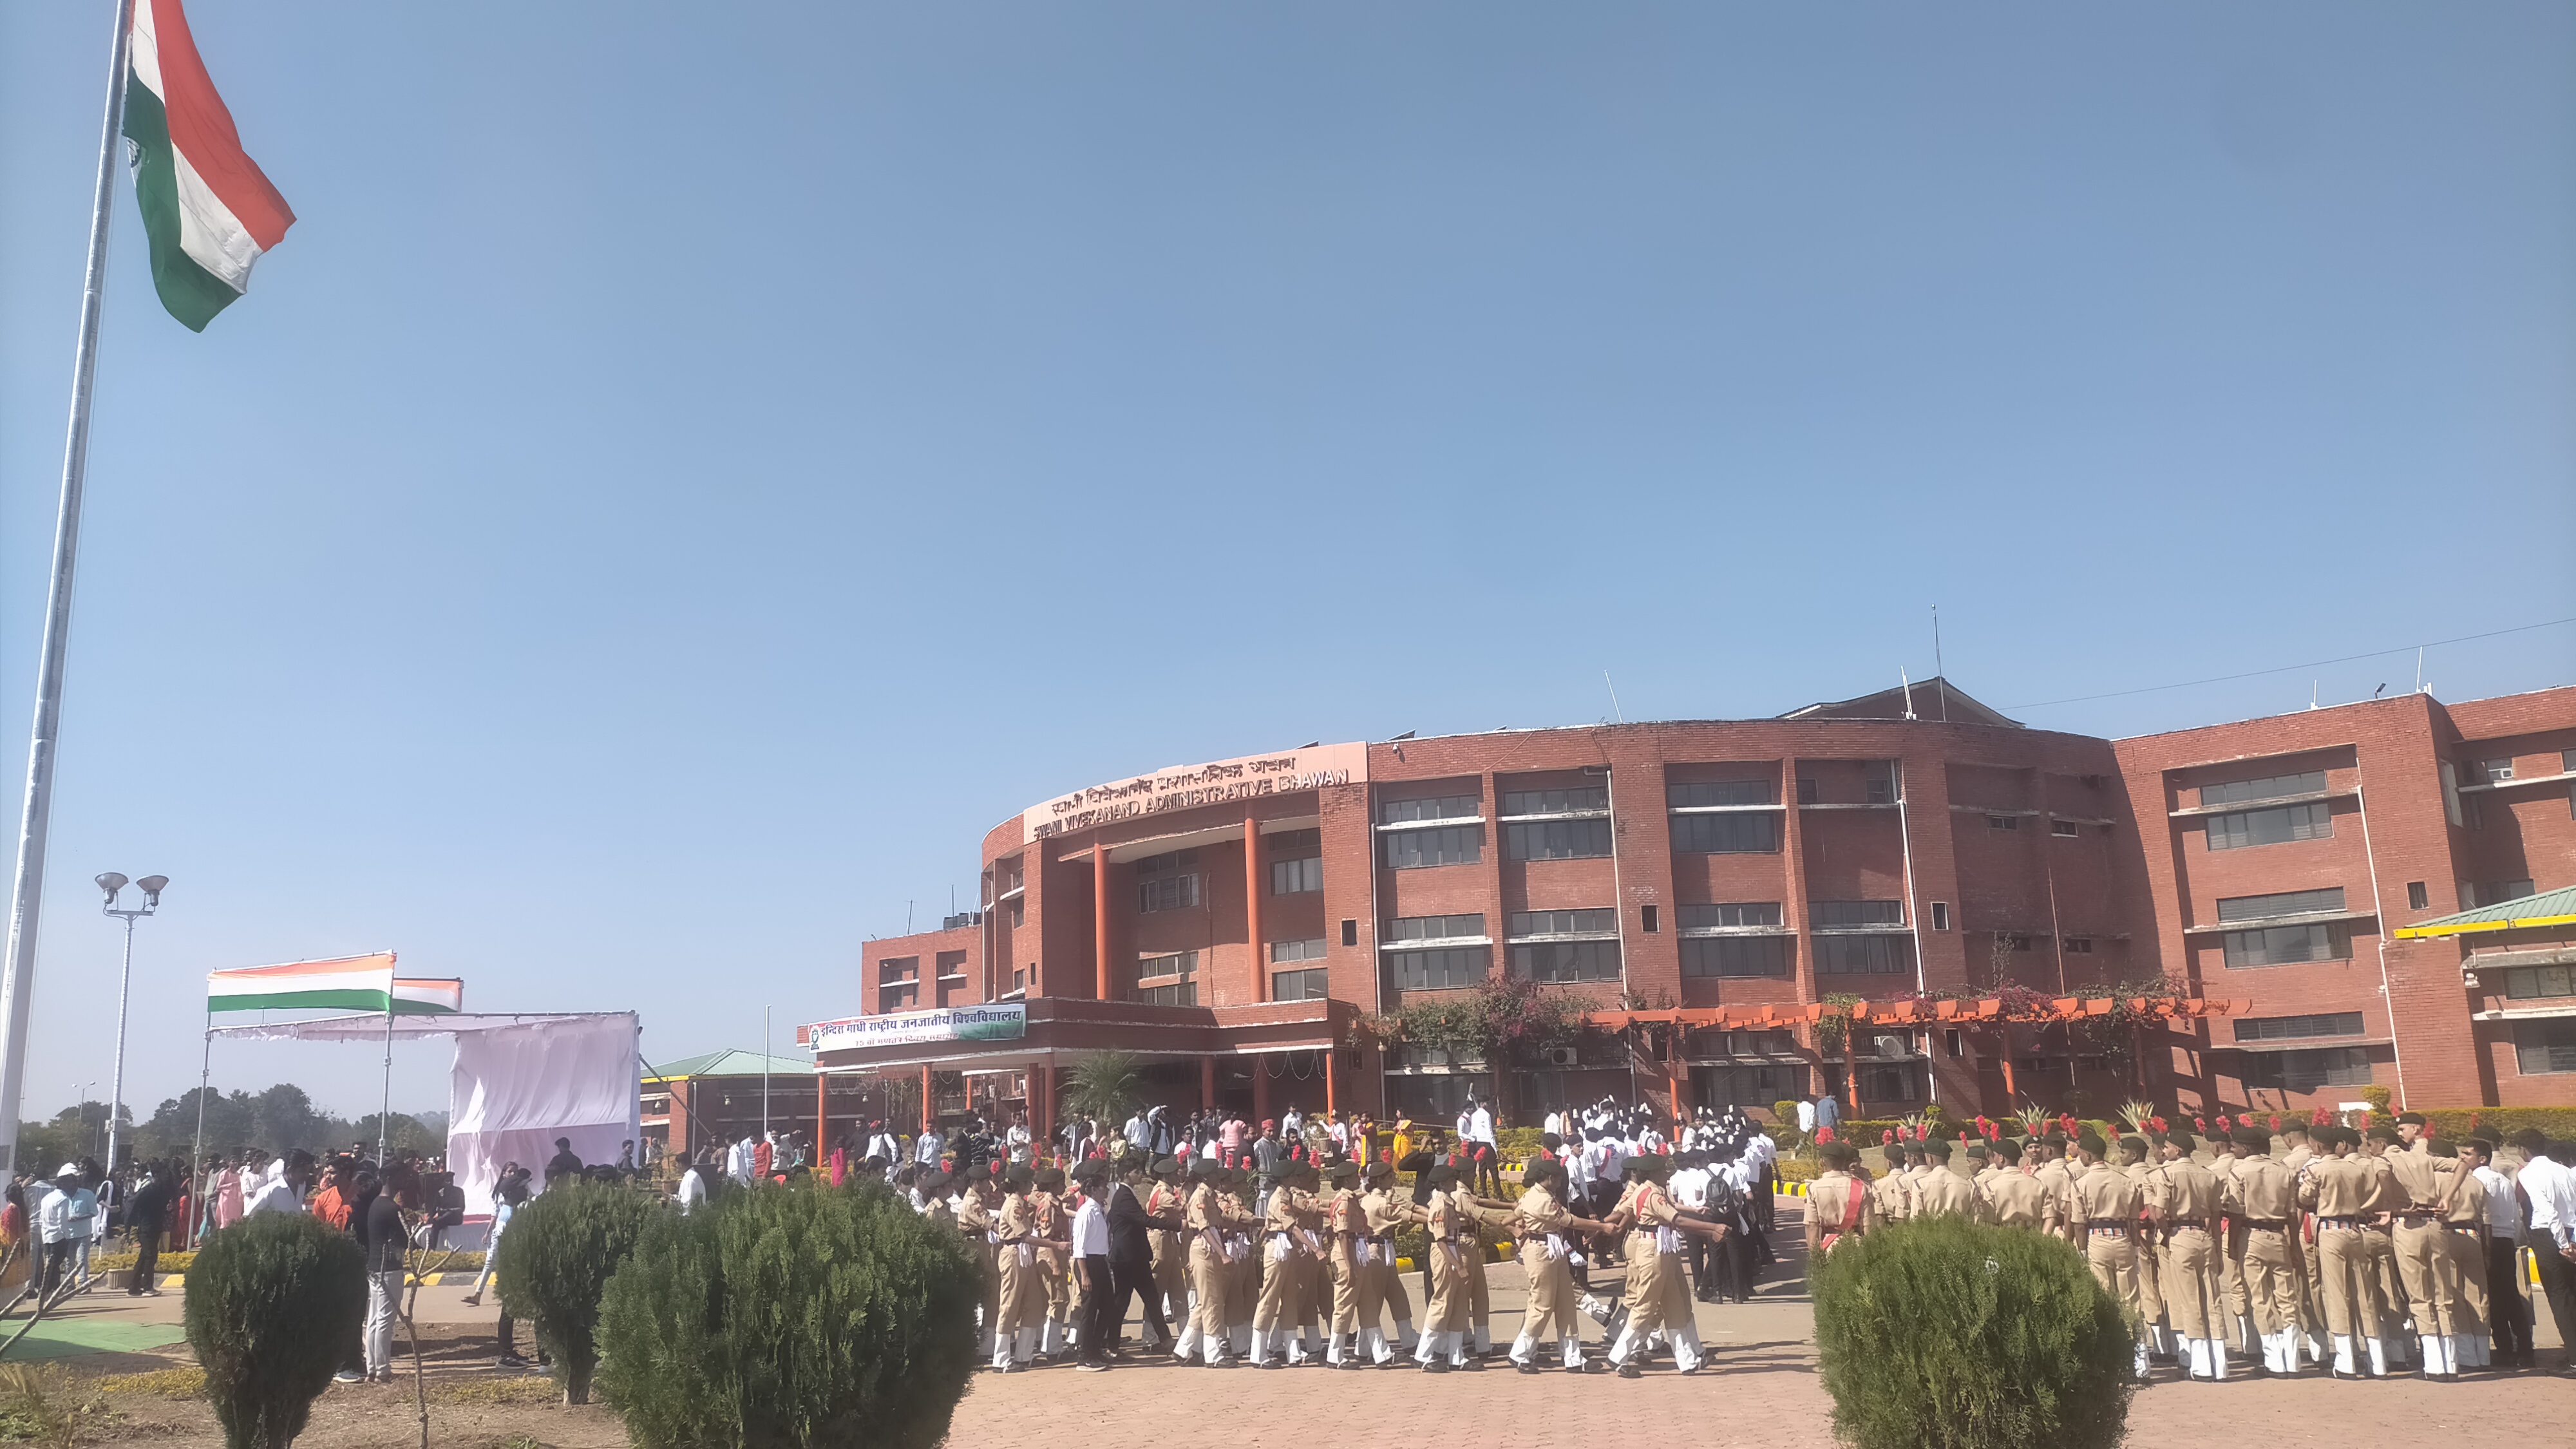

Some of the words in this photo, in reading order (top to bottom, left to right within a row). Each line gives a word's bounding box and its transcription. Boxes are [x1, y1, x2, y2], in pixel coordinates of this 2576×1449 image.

[1034, 819, 1063, 839] SWAMI
[1065, 800, 1140, 831] VIVEKANAND
[1145, 778, 1273, 813] ADMINISTRATIVE
[1278, 768, 1349, 791] BHAWAN
[900, 1014, 951, 1029] जनजातीय
[952, 1010, 1021, 1025] विश्वविद्यालय
